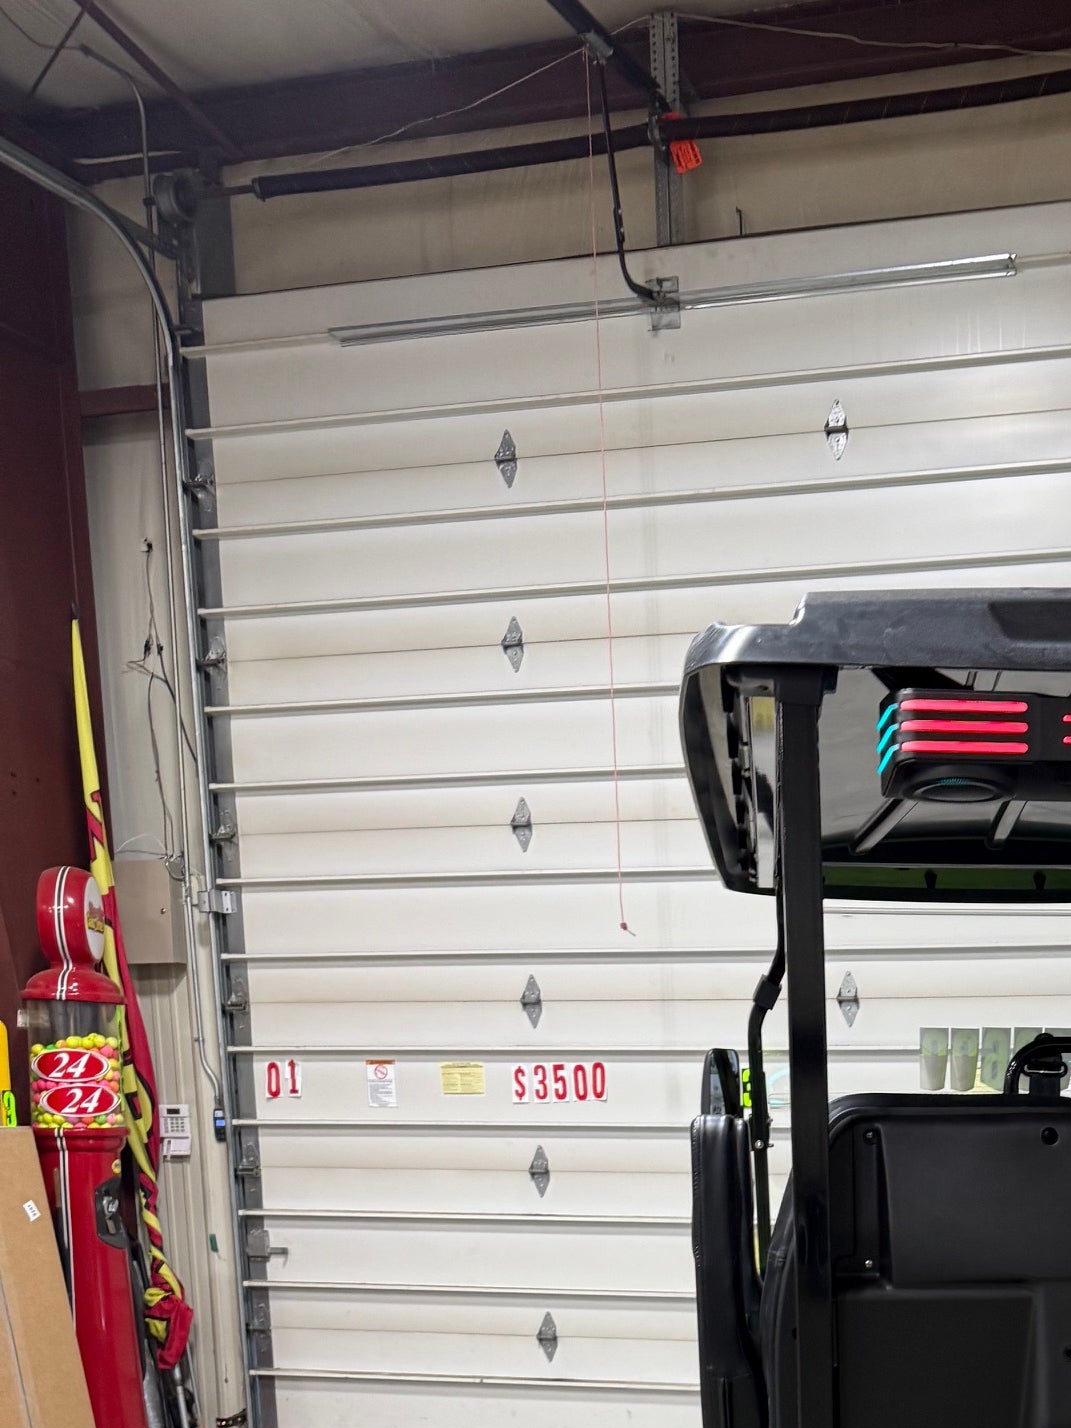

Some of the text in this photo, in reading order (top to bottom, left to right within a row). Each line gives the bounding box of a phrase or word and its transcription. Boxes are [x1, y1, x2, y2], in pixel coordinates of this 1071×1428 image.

[48, 1052, 91, 1078] 24
[514, 1062, 606, 1101] $3500
[60, 1087, 103, 1113] 24
